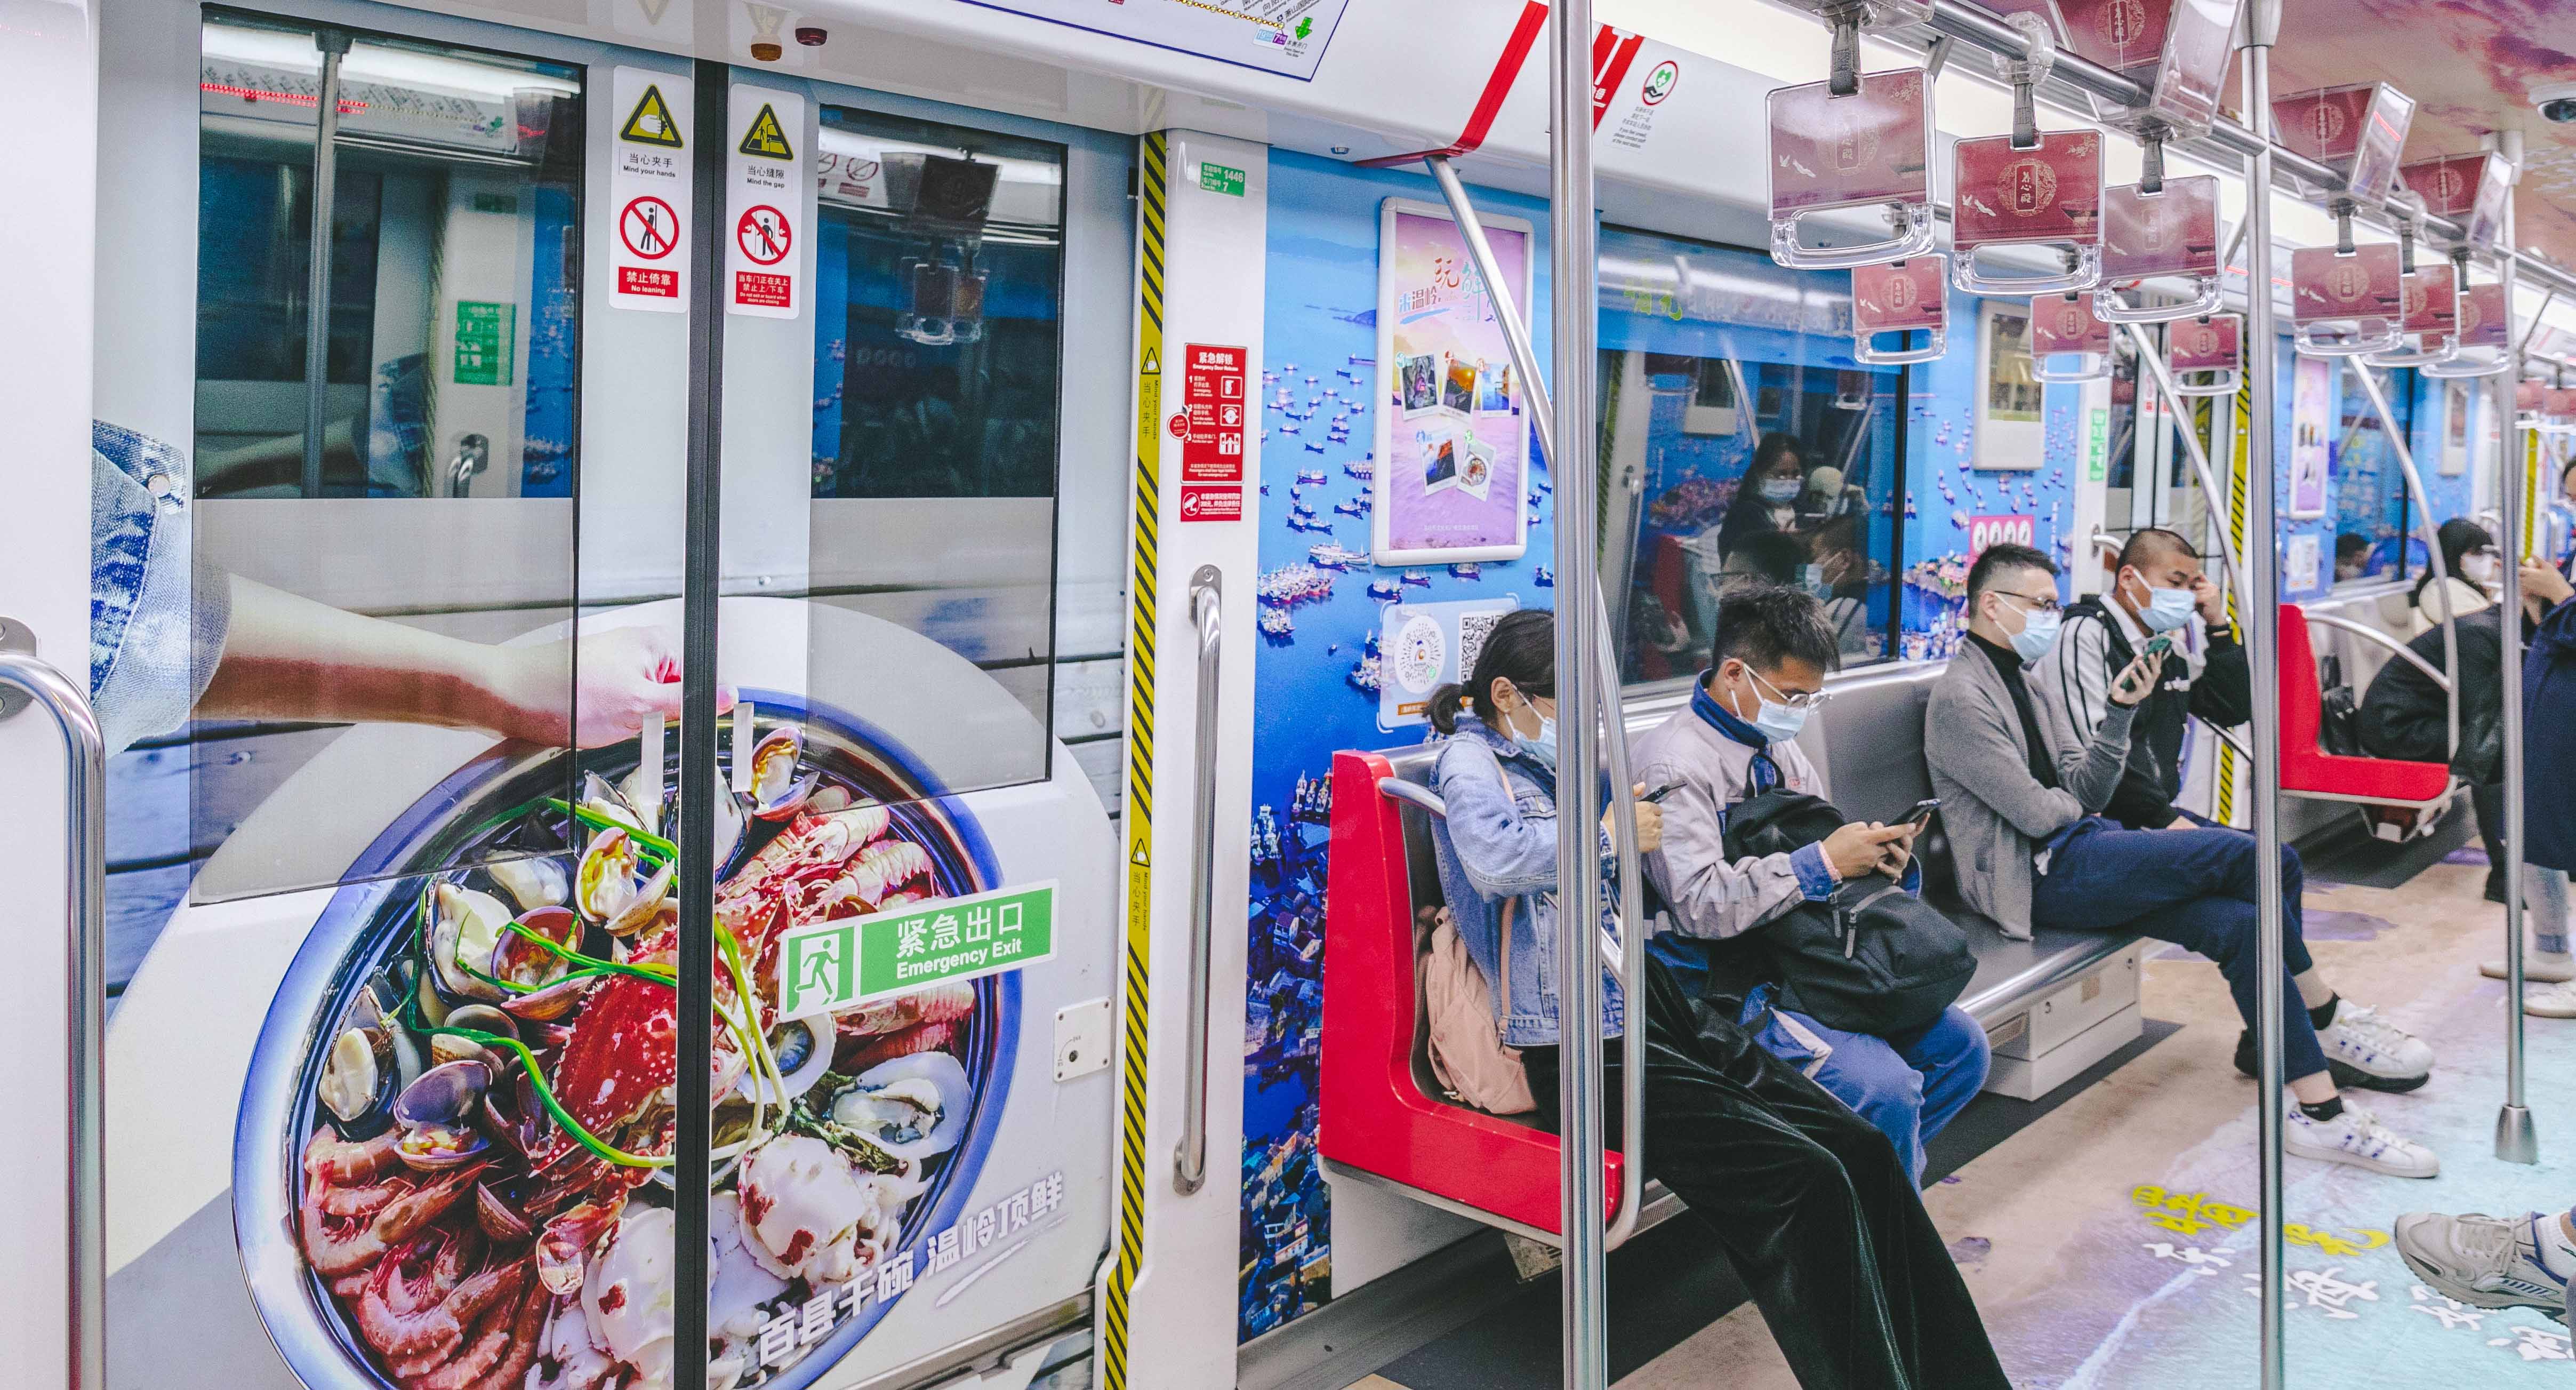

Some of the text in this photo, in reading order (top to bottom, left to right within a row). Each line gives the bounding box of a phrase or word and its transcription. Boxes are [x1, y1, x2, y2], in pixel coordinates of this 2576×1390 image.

[629, 153, 673, 168] 当心夹手
[657, 170, 676, 178] hands
[747, 164, 784, 179] 当心缝隙
[627, 270, 671, 286] 禁止倚靠
[739, 274, 788, 286] 当车门正在关上
[642, 286, 665, 295] leaning
[743, 283, 784, 294] 禁止上/下车
[1143, 381, 1151, 438] 当心夹手
[896, 901, 1023, 959] 紧急出口
[897, 938, 1022, 980] Emergency Exit
[760, 1171, 1064, 1367] 百县千碗 温岭顶鲜
